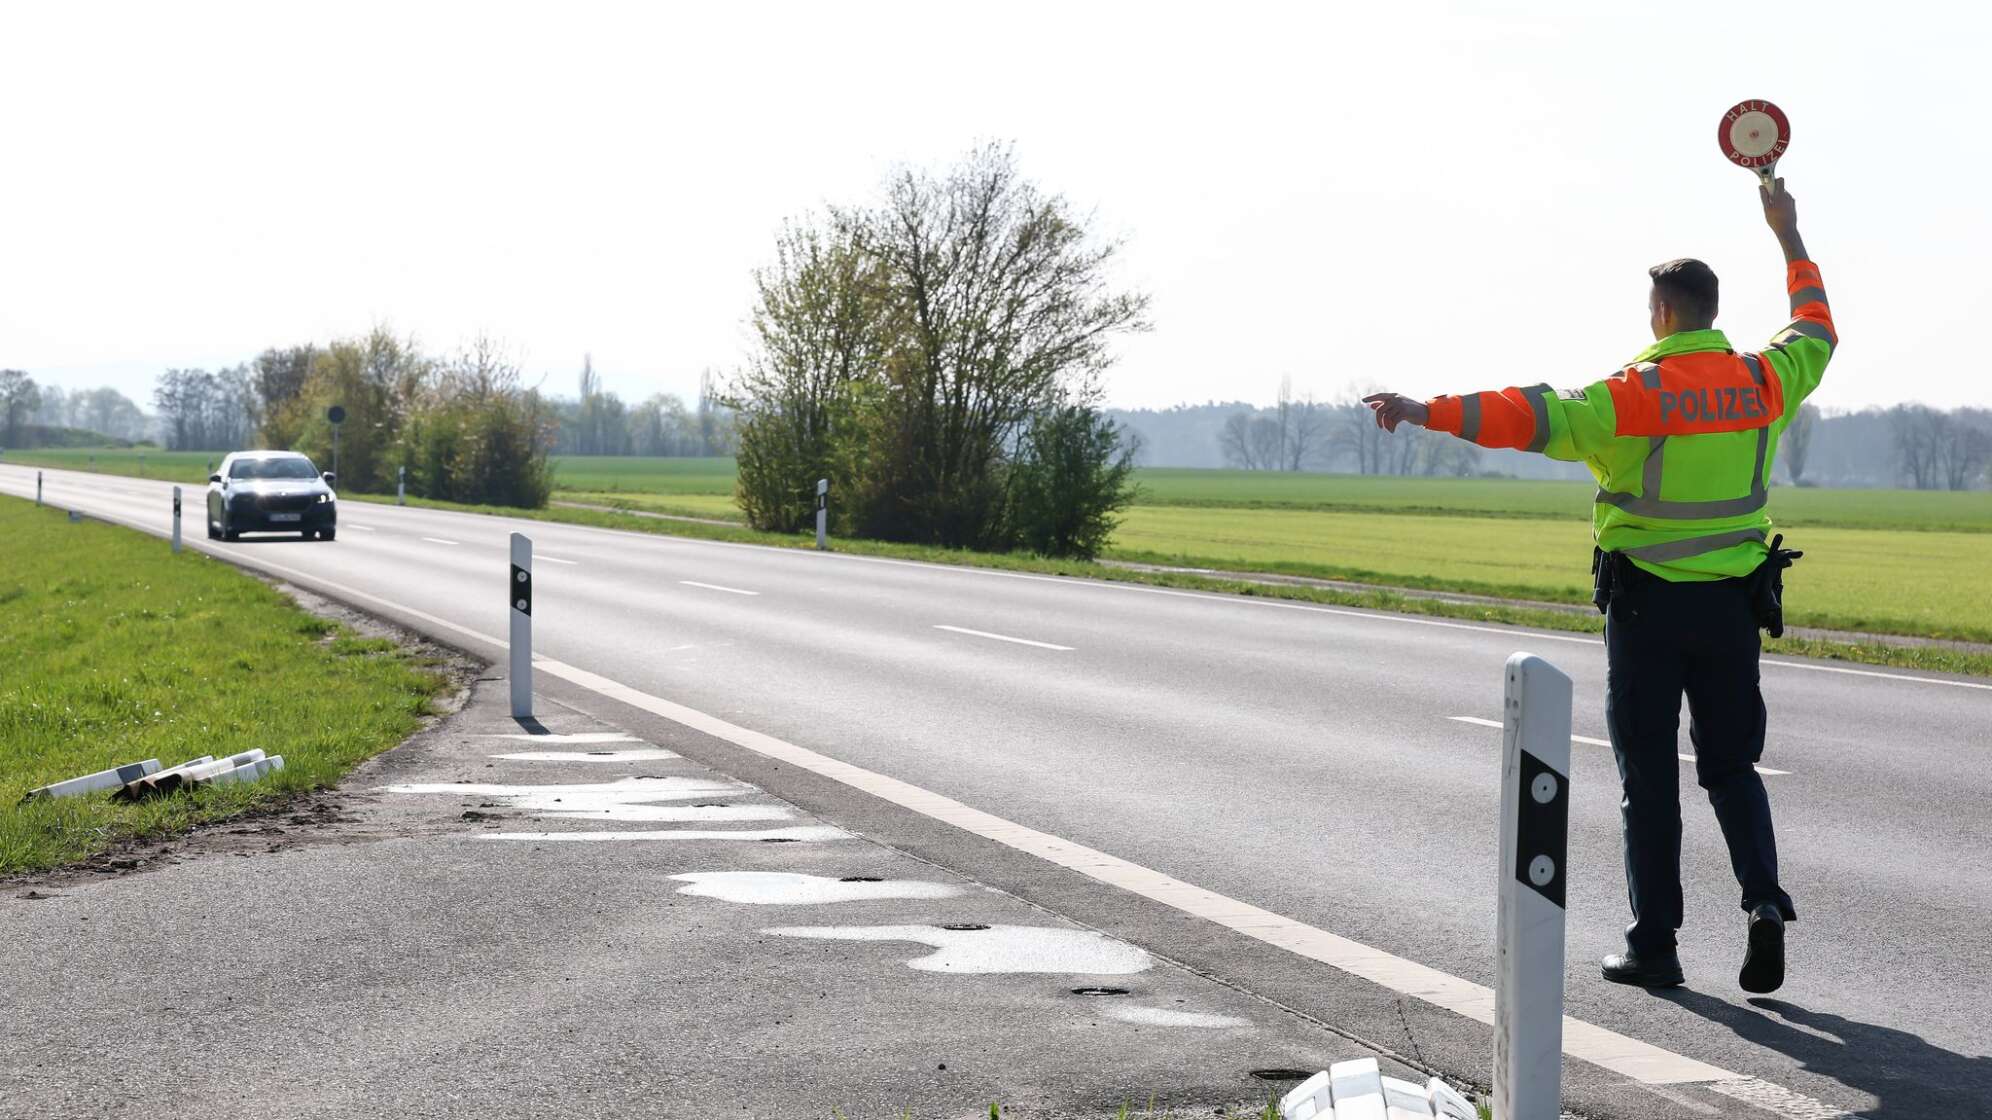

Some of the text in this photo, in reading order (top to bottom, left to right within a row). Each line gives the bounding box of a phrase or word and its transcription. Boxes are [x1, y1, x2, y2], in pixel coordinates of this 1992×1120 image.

[1727, 101, 1769, 121] HALT
[1729, 139, 1788, 167] POLIZEI
[1659, 386, 1769, 424] POLIZEI
